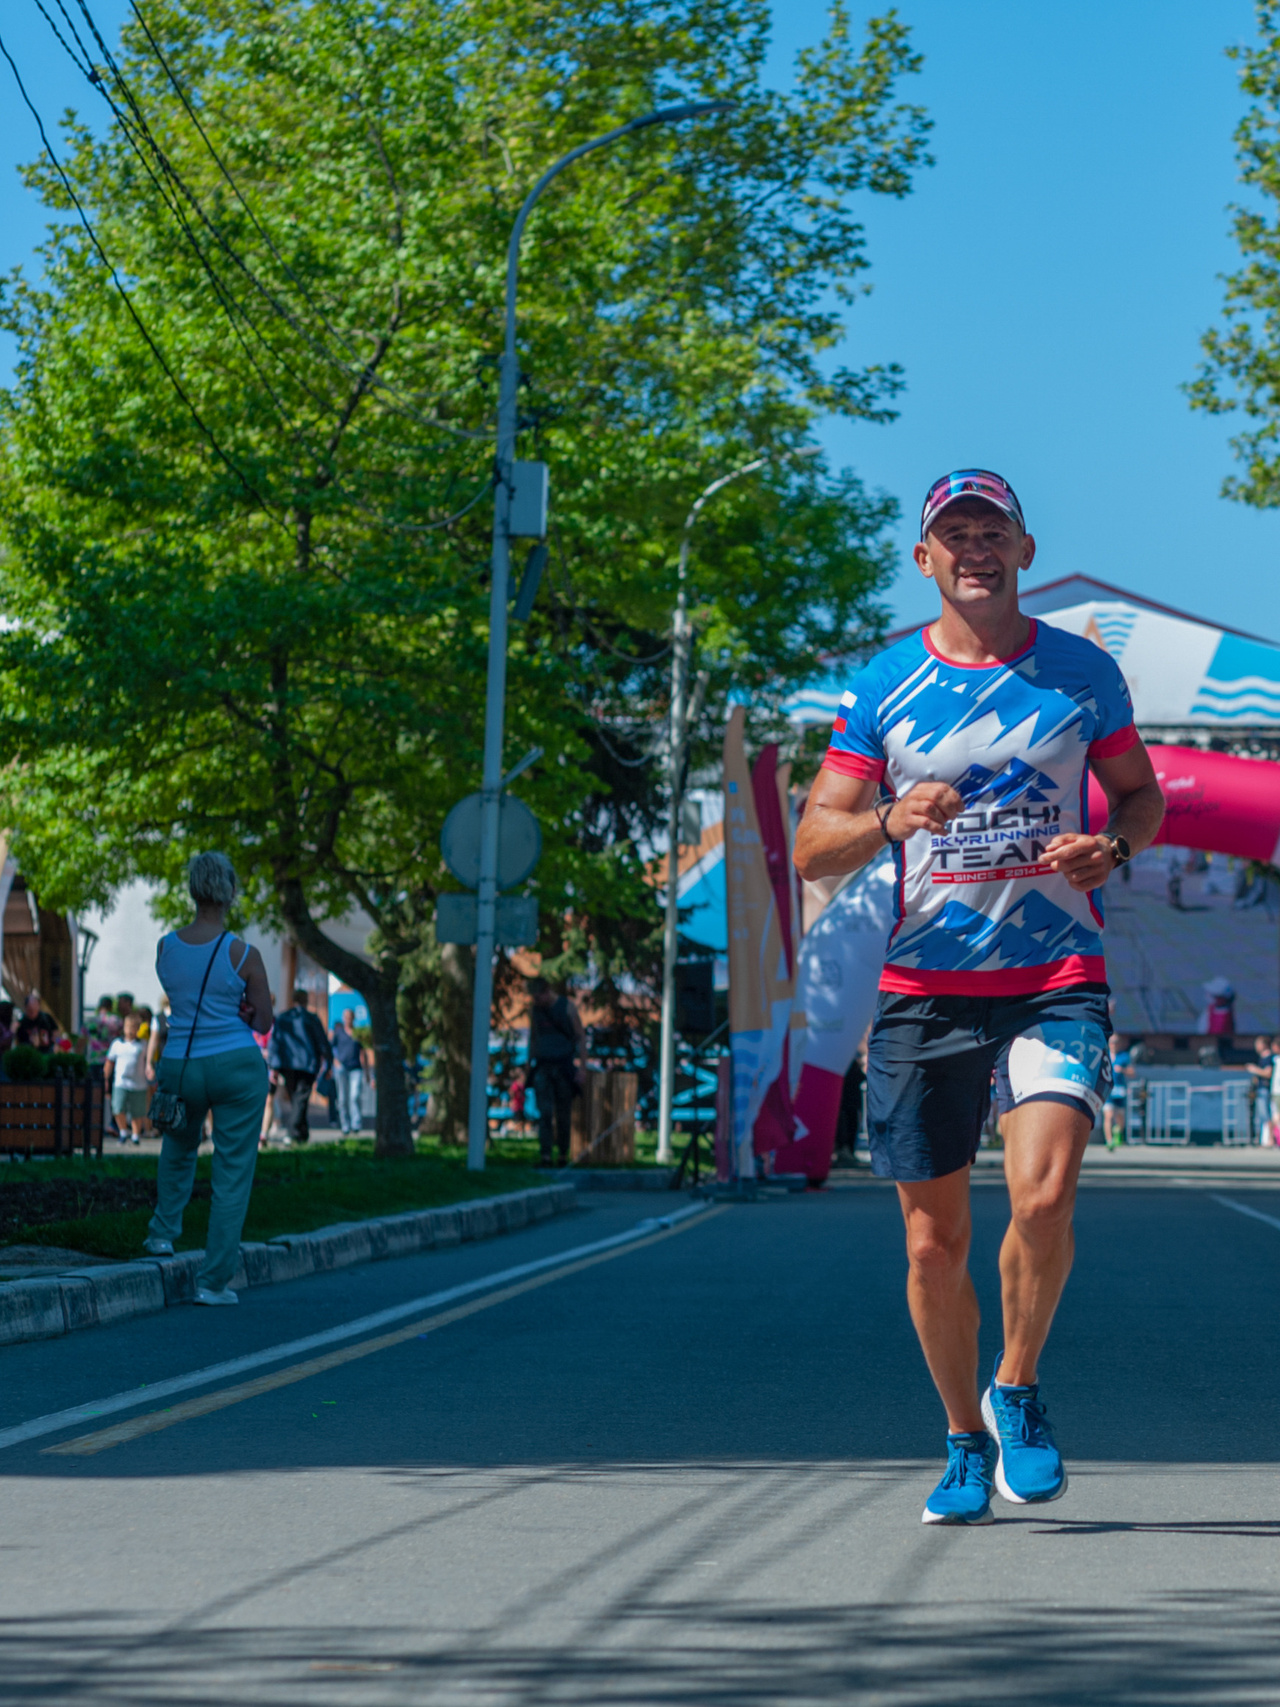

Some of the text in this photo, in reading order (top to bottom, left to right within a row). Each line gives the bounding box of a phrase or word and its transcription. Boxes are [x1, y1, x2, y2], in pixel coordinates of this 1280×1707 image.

[931, 804, 1061, 838] OCHI
[930, 824, 1061, 848] SKYRUNNING
[953, 866, 1037, 882] SINCE 2014
[1045, 1039, 1103, 1070] 237
